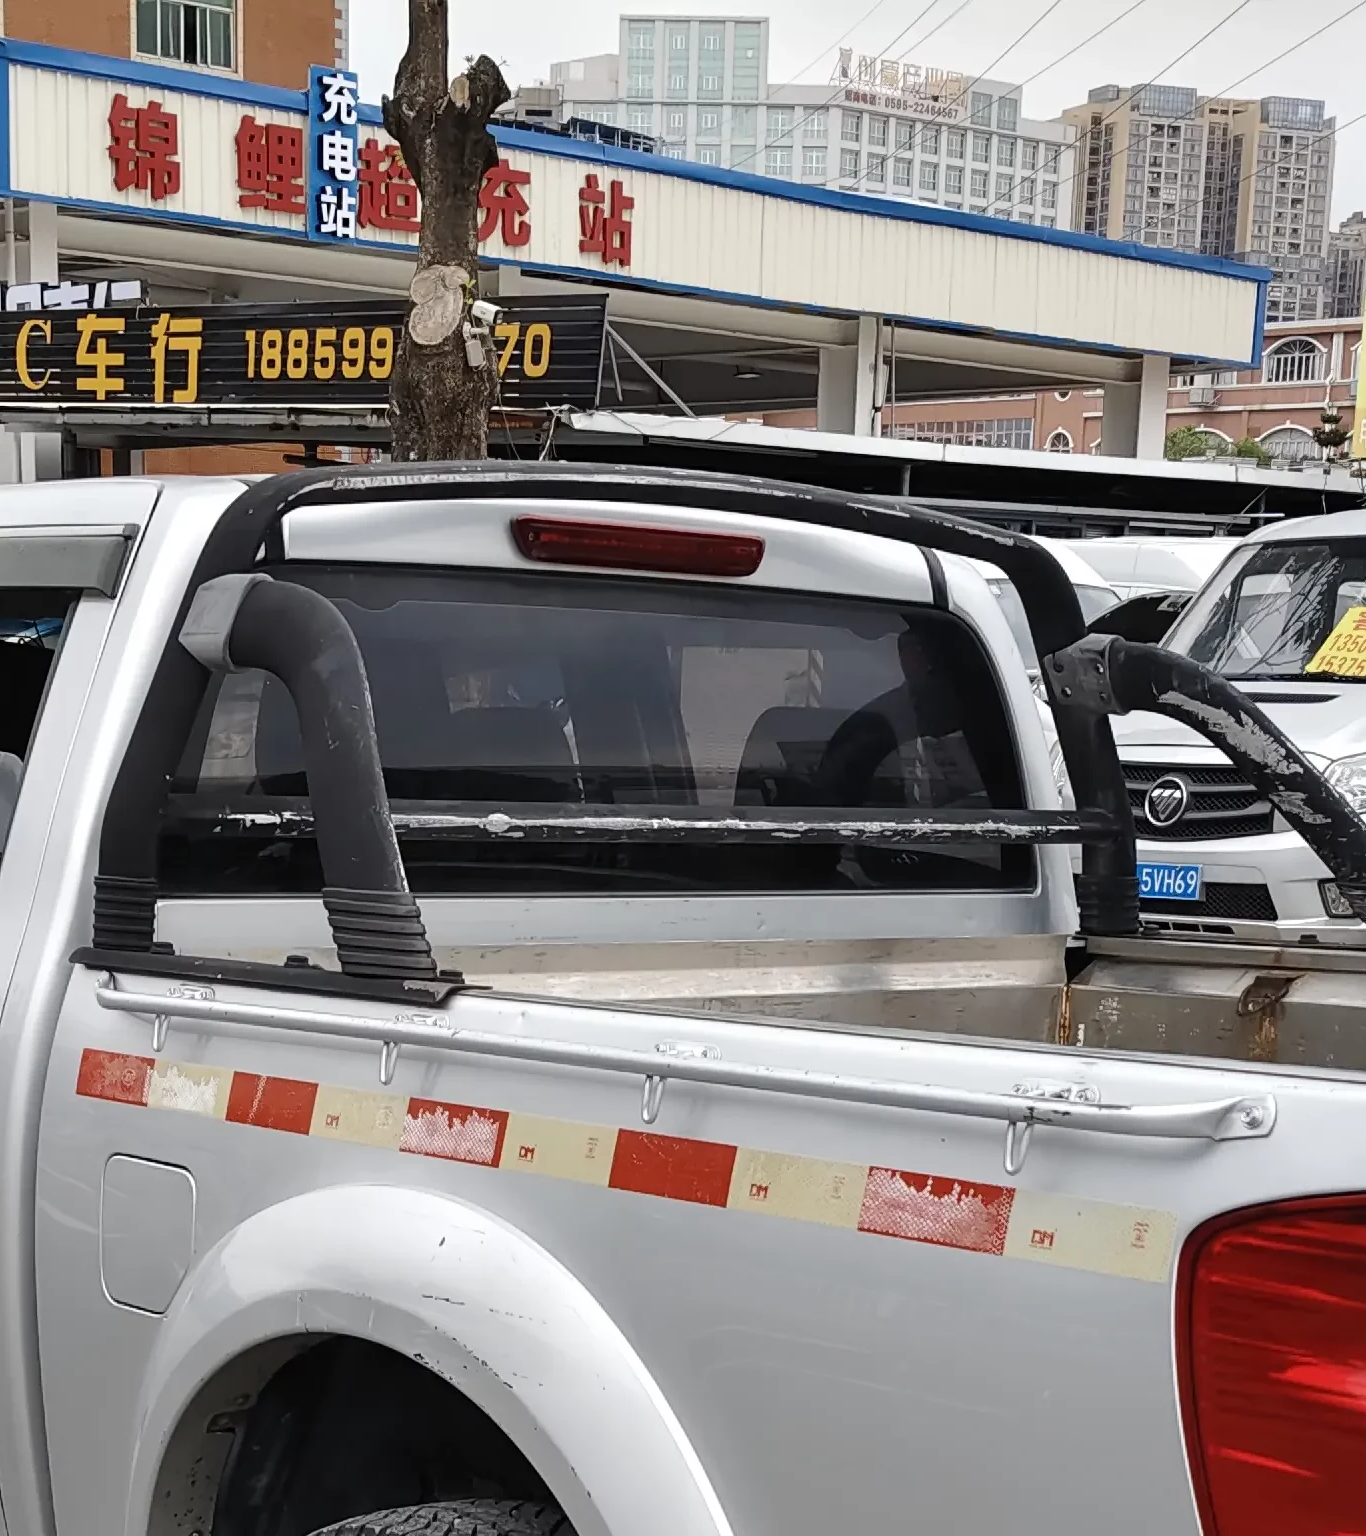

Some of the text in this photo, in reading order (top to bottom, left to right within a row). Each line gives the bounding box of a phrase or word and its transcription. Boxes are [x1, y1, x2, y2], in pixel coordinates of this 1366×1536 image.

[320, 73, 357, 240] 充电站
[244, 321, 552, 380] 18859970
